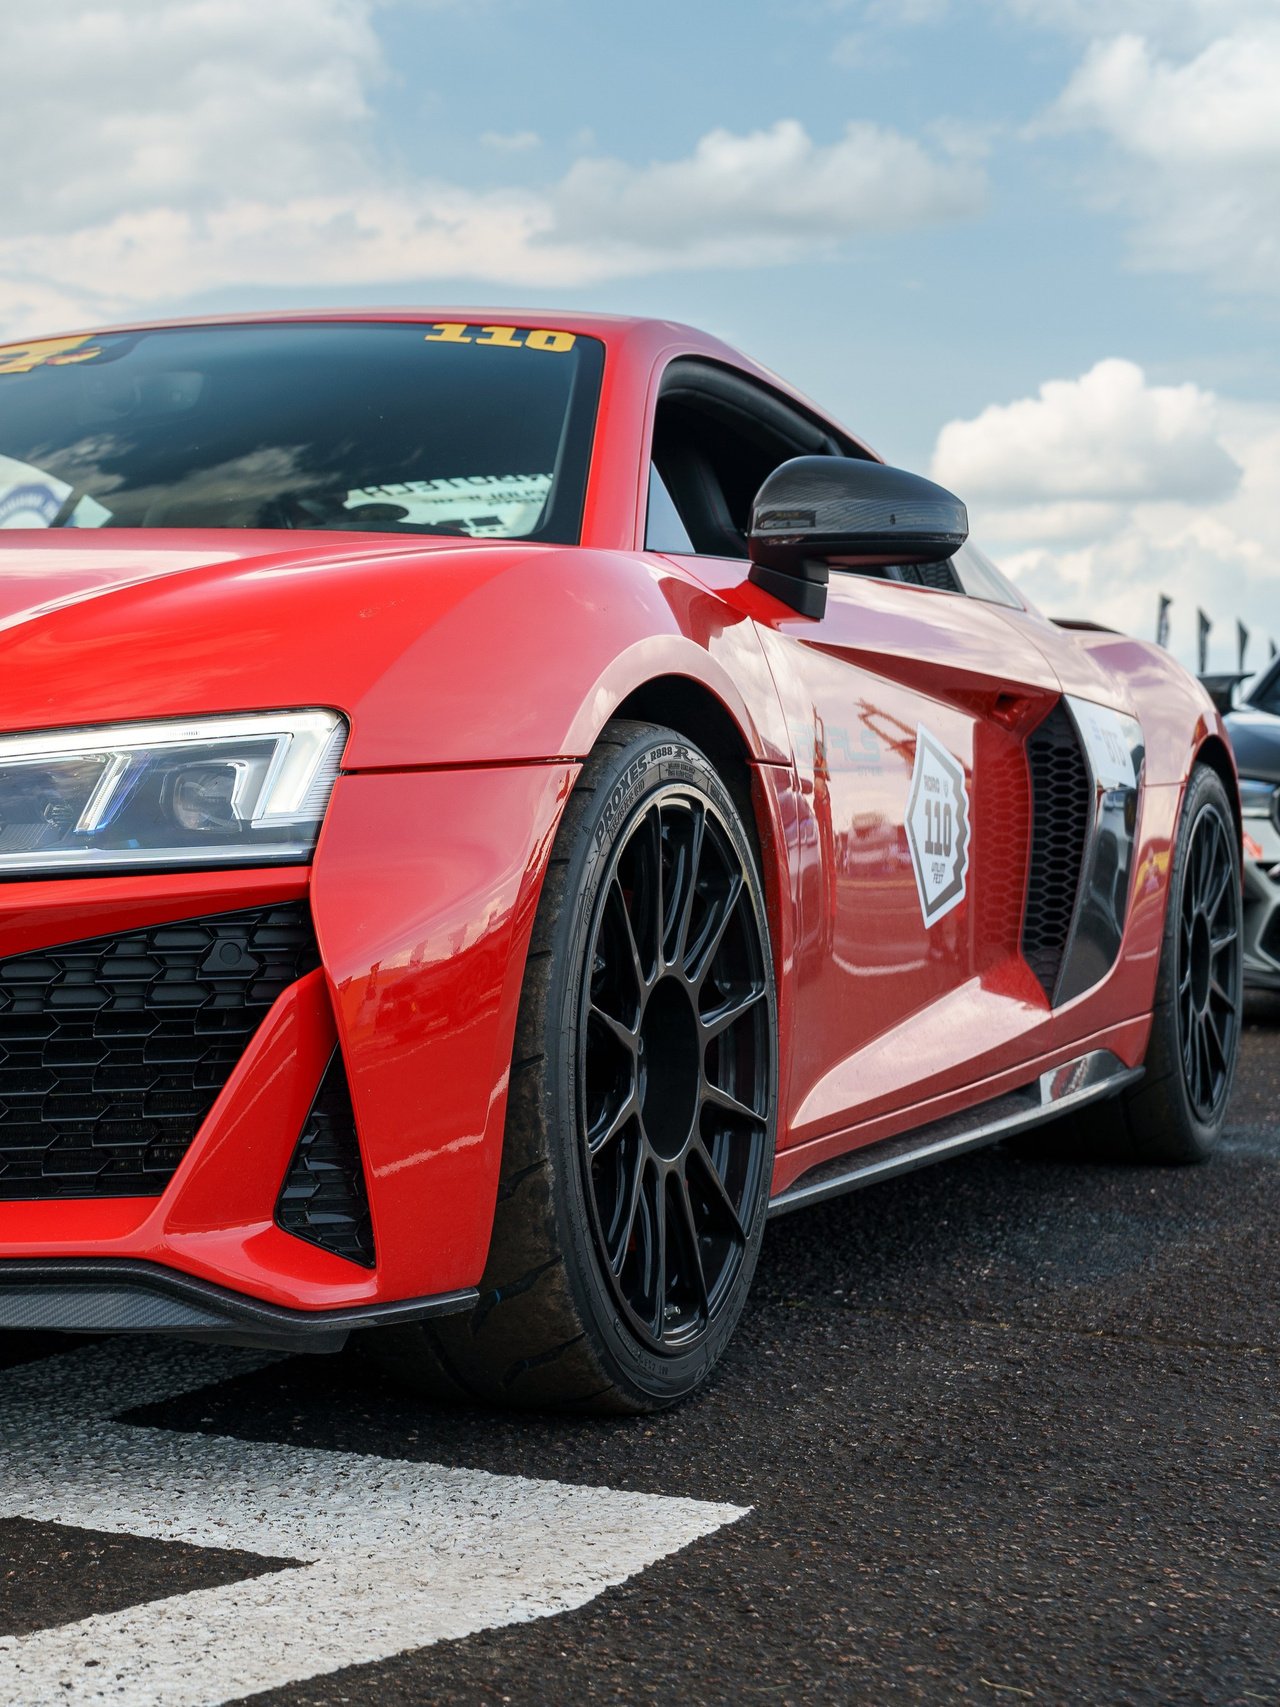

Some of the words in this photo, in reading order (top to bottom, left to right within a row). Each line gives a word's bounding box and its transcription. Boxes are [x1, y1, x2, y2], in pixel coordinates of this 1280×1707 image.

[424, 323, 577, 353] 110
[594, 754, 648, 849] PROXES
[924, 798, 952, 858] 110
